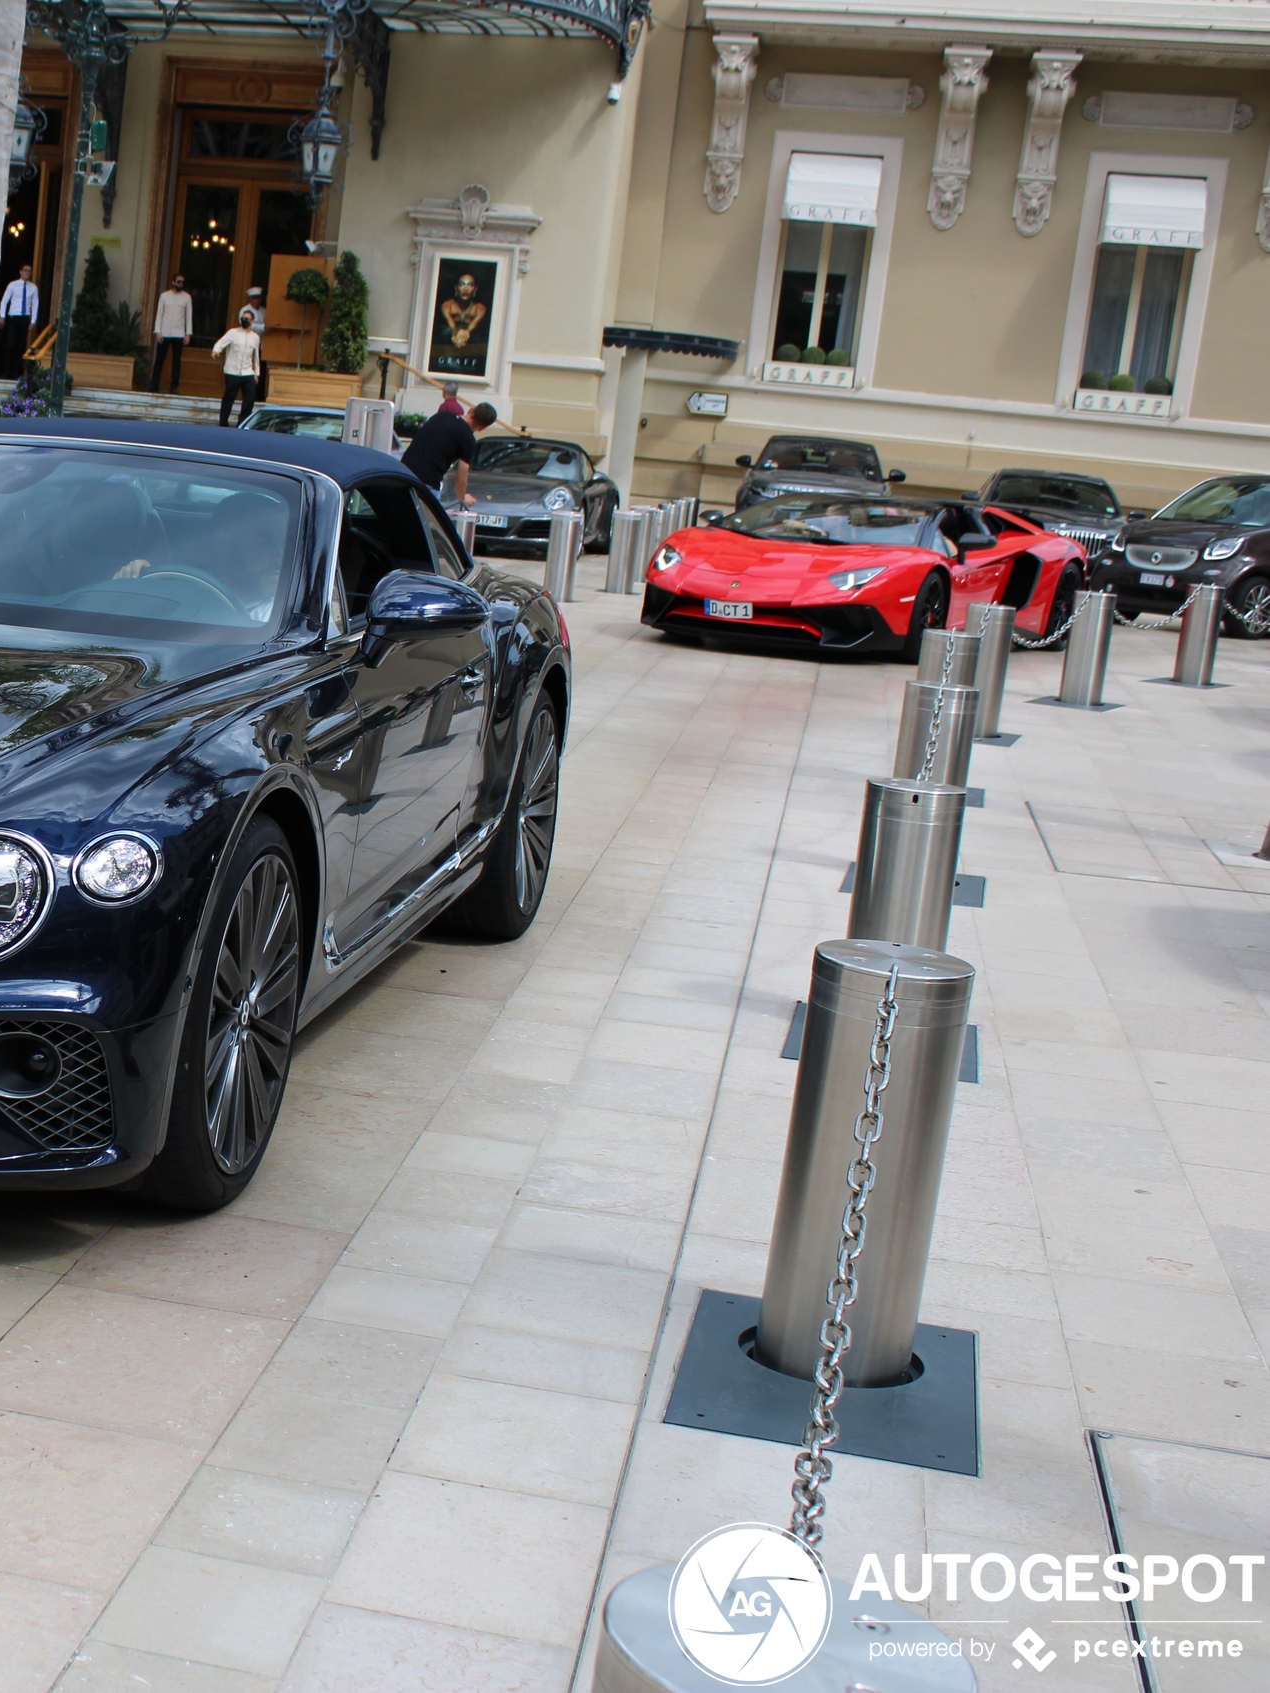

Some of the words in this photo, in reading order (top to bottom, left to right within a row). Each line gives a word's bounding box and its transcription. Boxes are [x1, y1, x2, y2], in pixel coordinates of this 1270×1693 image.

[789, 204, 868, 222] GRAFF
[1112, 227, 1195, 245] GRAFF
[438, 356, 478, 367] GRAFF
[770, 366, 847, 385] GRAFF
[1081, 395, 1164, 414] GRAFF
